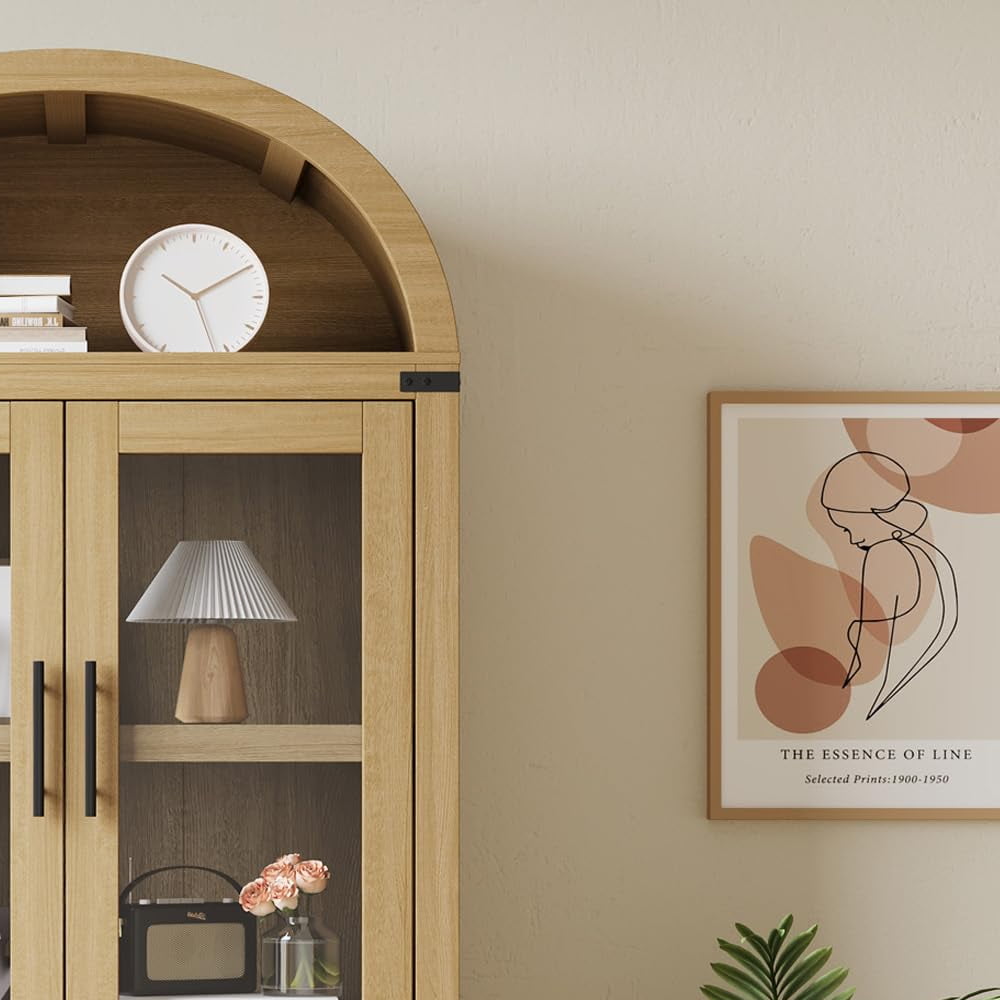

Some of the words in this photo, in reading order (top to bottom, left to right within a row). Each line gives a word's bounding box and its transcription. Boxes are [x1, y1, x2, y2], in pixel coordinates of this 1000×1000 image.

[780, 748, 815, 760] THE
[822, 748, 897, 760] ESSENCE
[903, 748, 925, 760] OF
[932, 748, 973, 760] LINE
[804, 774, 850, 784] Selected
[853, 774, 950, 784] Prints:1900-1950
